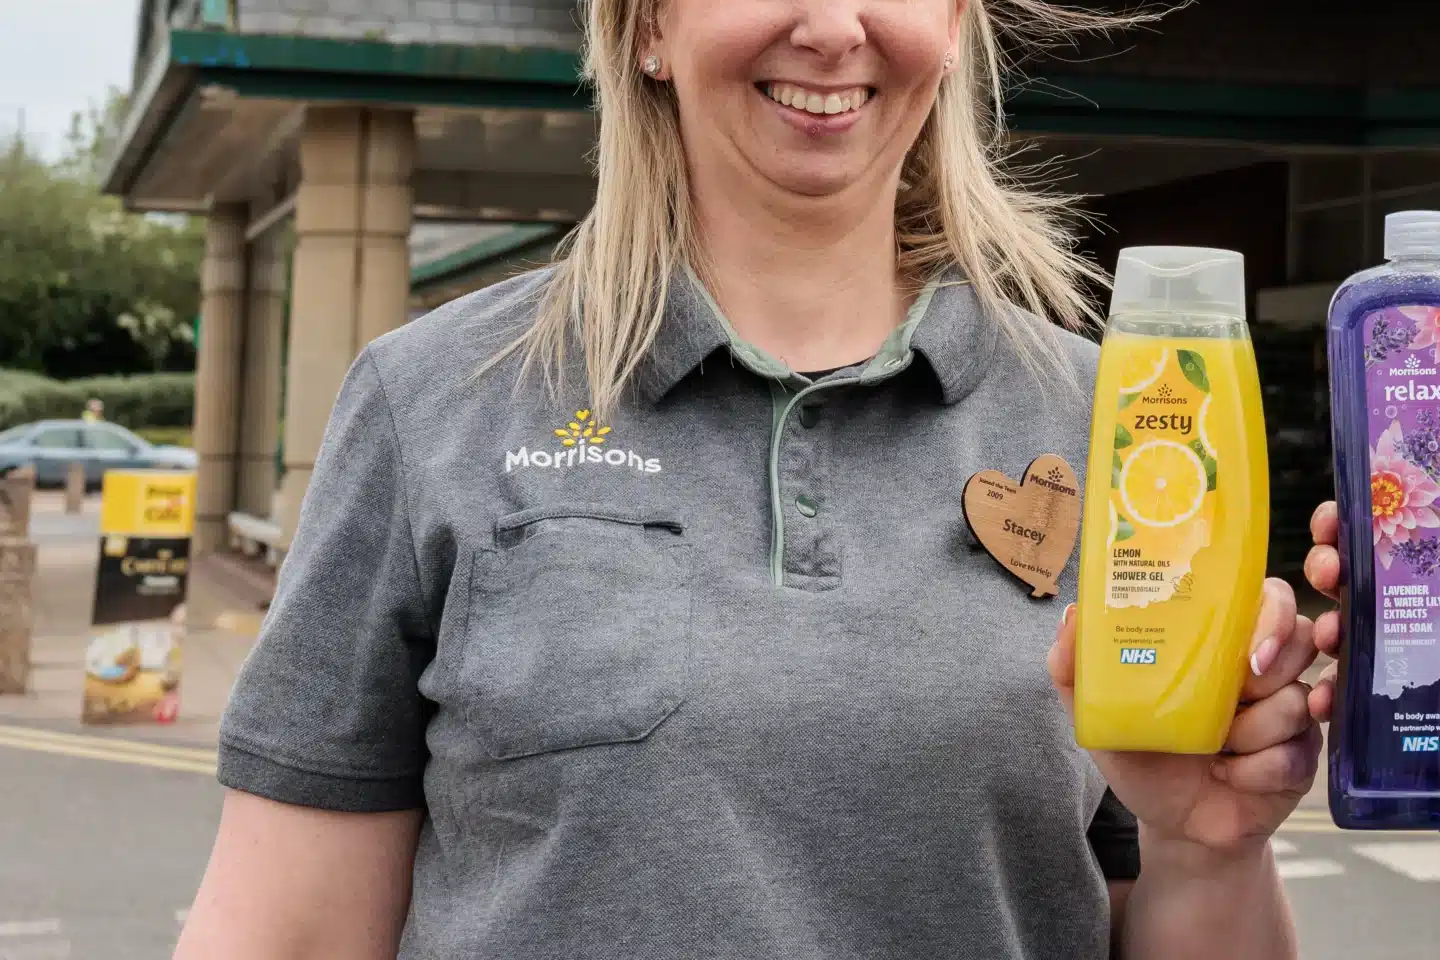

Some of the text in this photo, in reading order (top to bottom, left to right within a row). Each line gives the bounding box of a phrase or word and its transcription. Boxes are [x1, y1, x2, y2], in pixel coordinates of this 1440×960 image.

[1389, 367, 1437, 376] Morrisons
[1142, 395, 1188, 405] Morrisons
[1134, 413, 1192, 435] zesty
[505, 438, 662, 473] Morrisons
[1030, 473, 1076, 497] Morrisons
[986, 489, 1004, 501] 2009
[1003, 518, 1047, 545] Stacey
[1113, 548, 1141, 558] LEMON
[1010, 558, 1027, 570] Love
[1036, 566, 1052, 578] Help
[1157, 560, 1171, 568] OILS
[1112, 571, 1164, 581] SHOWER GEL
[1383, 584, 1429, 596] LAVENDER
[1384, 597, 1392, 607] &
[1393, 597, 1424, 607] WATER
[1384, 609, 1428, 619] EXTRACTS
[1115, 625, 1124, 633] Be
[1126, 625, 1143, 635] body
[1384, 622, 1433, 633] BATH SOAK
[1121, 648, 1156, 663] NHS
[1394, 712, 1404, 720] Be
[1405, 712, 1424, 721] body
[1400, 724, 1435, 732] partnership
[1402, 736, 1440, 752] NHS
